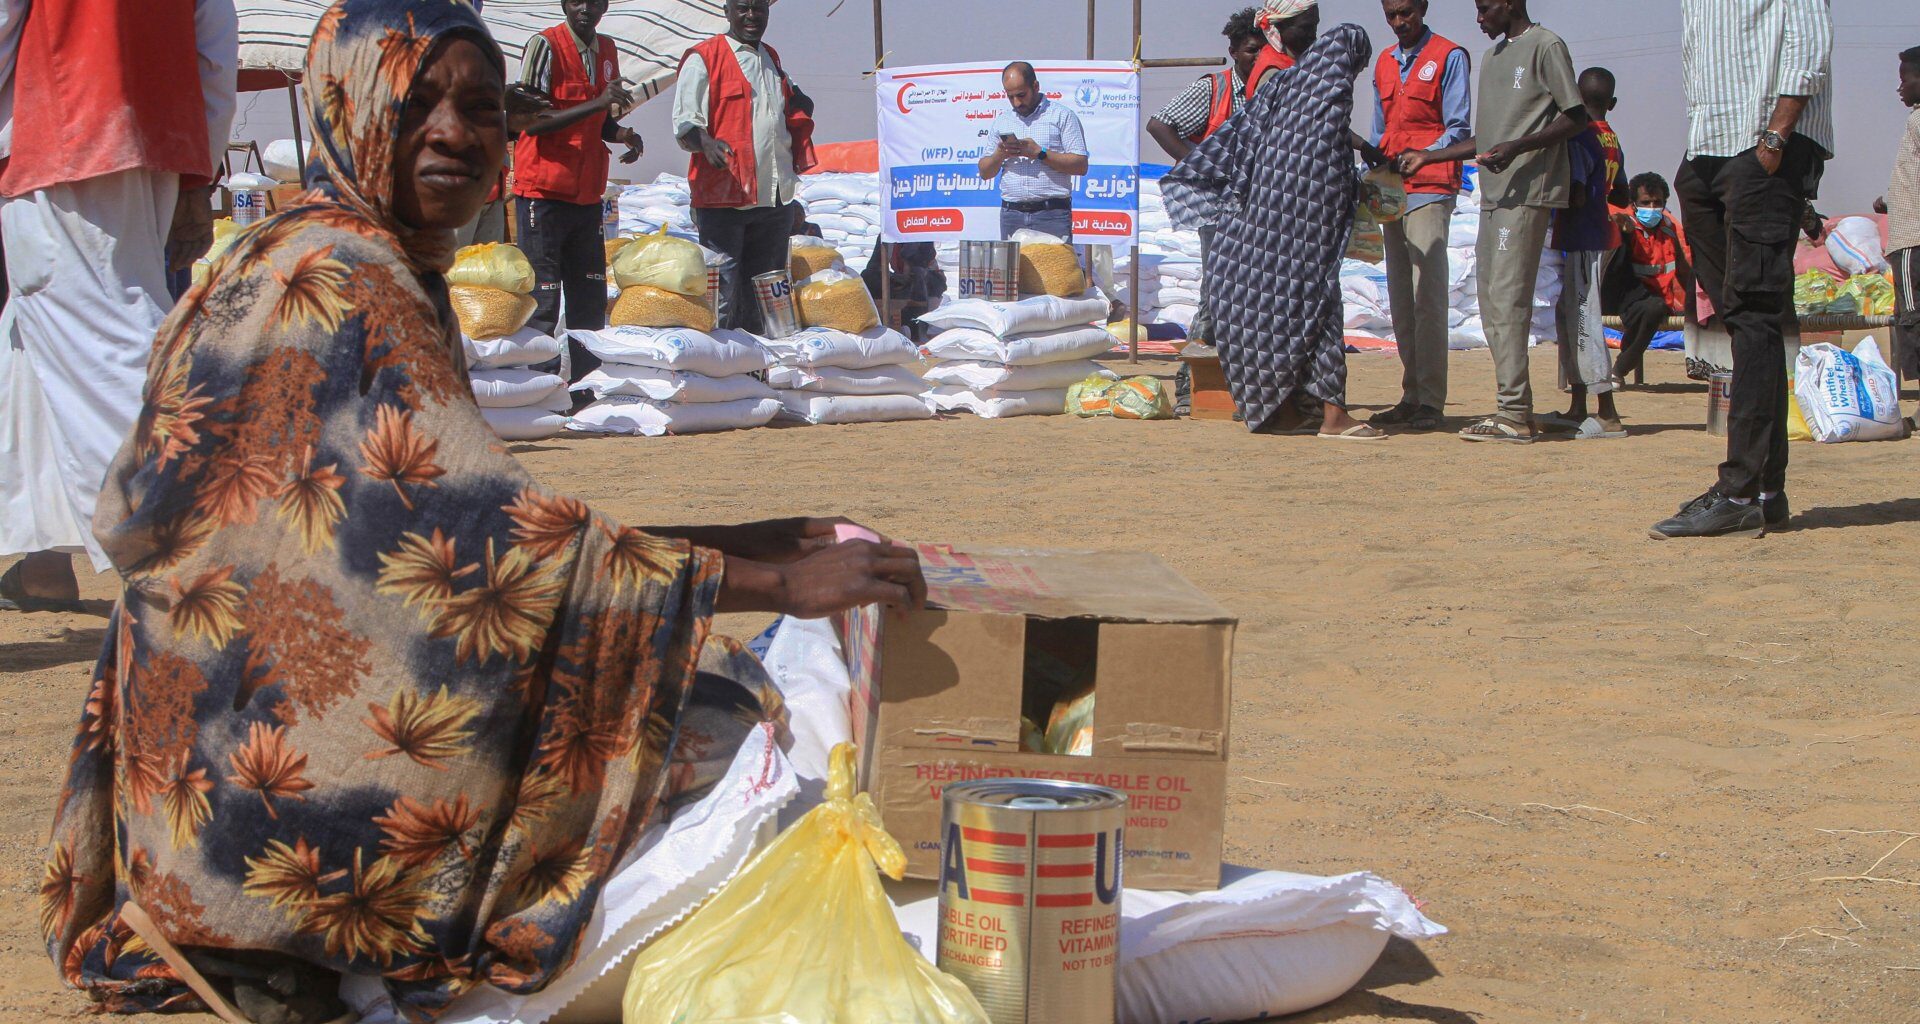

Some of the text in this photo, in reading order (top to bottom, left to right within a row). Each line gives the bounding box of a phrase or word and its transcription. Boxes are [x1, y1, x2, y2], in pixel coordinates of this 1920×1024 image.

[1513, 77, 1521, 89] K
[986, 90, 1008, 101] لاحمر
[1044, 91, 1063, 99] جمع
[965, 109, 997, 121] الشمالية
[921, 146, 954, 162] (WFP)
[892, 174, 933, 198] للنازحين
[1085, 174, 1136, 198] توزيع
[929, 216, 952, 227] مخيم
[1091, 219, 1127, 232] بمحلية
[1498, 238, 1508, 250] K
[770, 280, 790, 298] US
[960, 279, 975, 295] US
[1832, 349, 1845, 373] Flour
[1825, 367, 1840, 408] Fortified
[1837, 374, 1850, 408] Wheat
[1869, 378, 1881, 403] USAID
[916, 764, 1015, 781] REFINED
[1155, 775, 1192, 792] OIL
[1127, 793, 1182, 811] IFIED
[920, 841, 941, 850] CAN
[979, 915, 1008, 933] OIL
[1061, 913, 1117, 935] REFINED
[943, 925, 1008, 952] ORTIFIED
[1058, 933, 1113, 954] VITAMIN
[1063, 959, 1087, 971] NOT
[1090, 957, 1102, 968] TO
